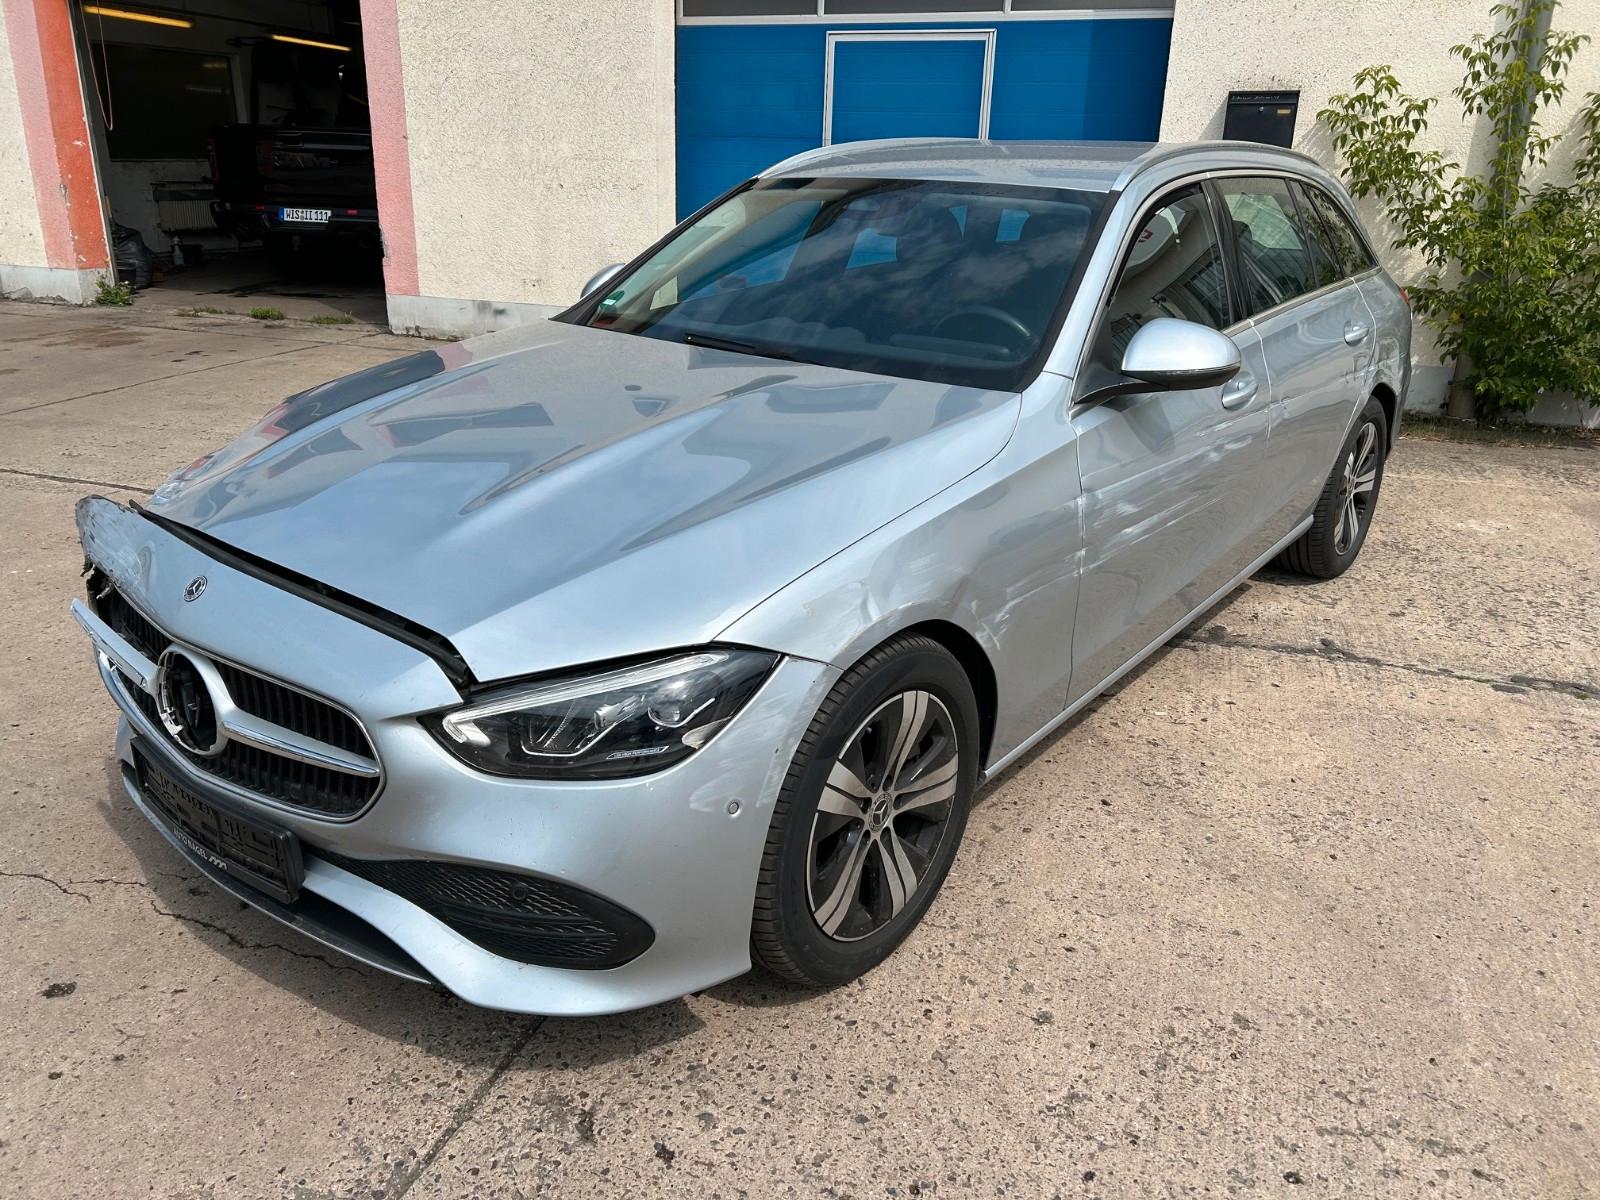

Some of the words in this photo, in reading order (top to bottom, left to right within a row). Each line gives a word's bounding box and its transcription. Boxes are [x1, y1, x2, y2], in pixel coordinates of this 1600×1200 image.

[286, 209, 300, 219] WIS
[314, 210, 328, 221] 111
[187, 839, 208, 860] NAGEL
